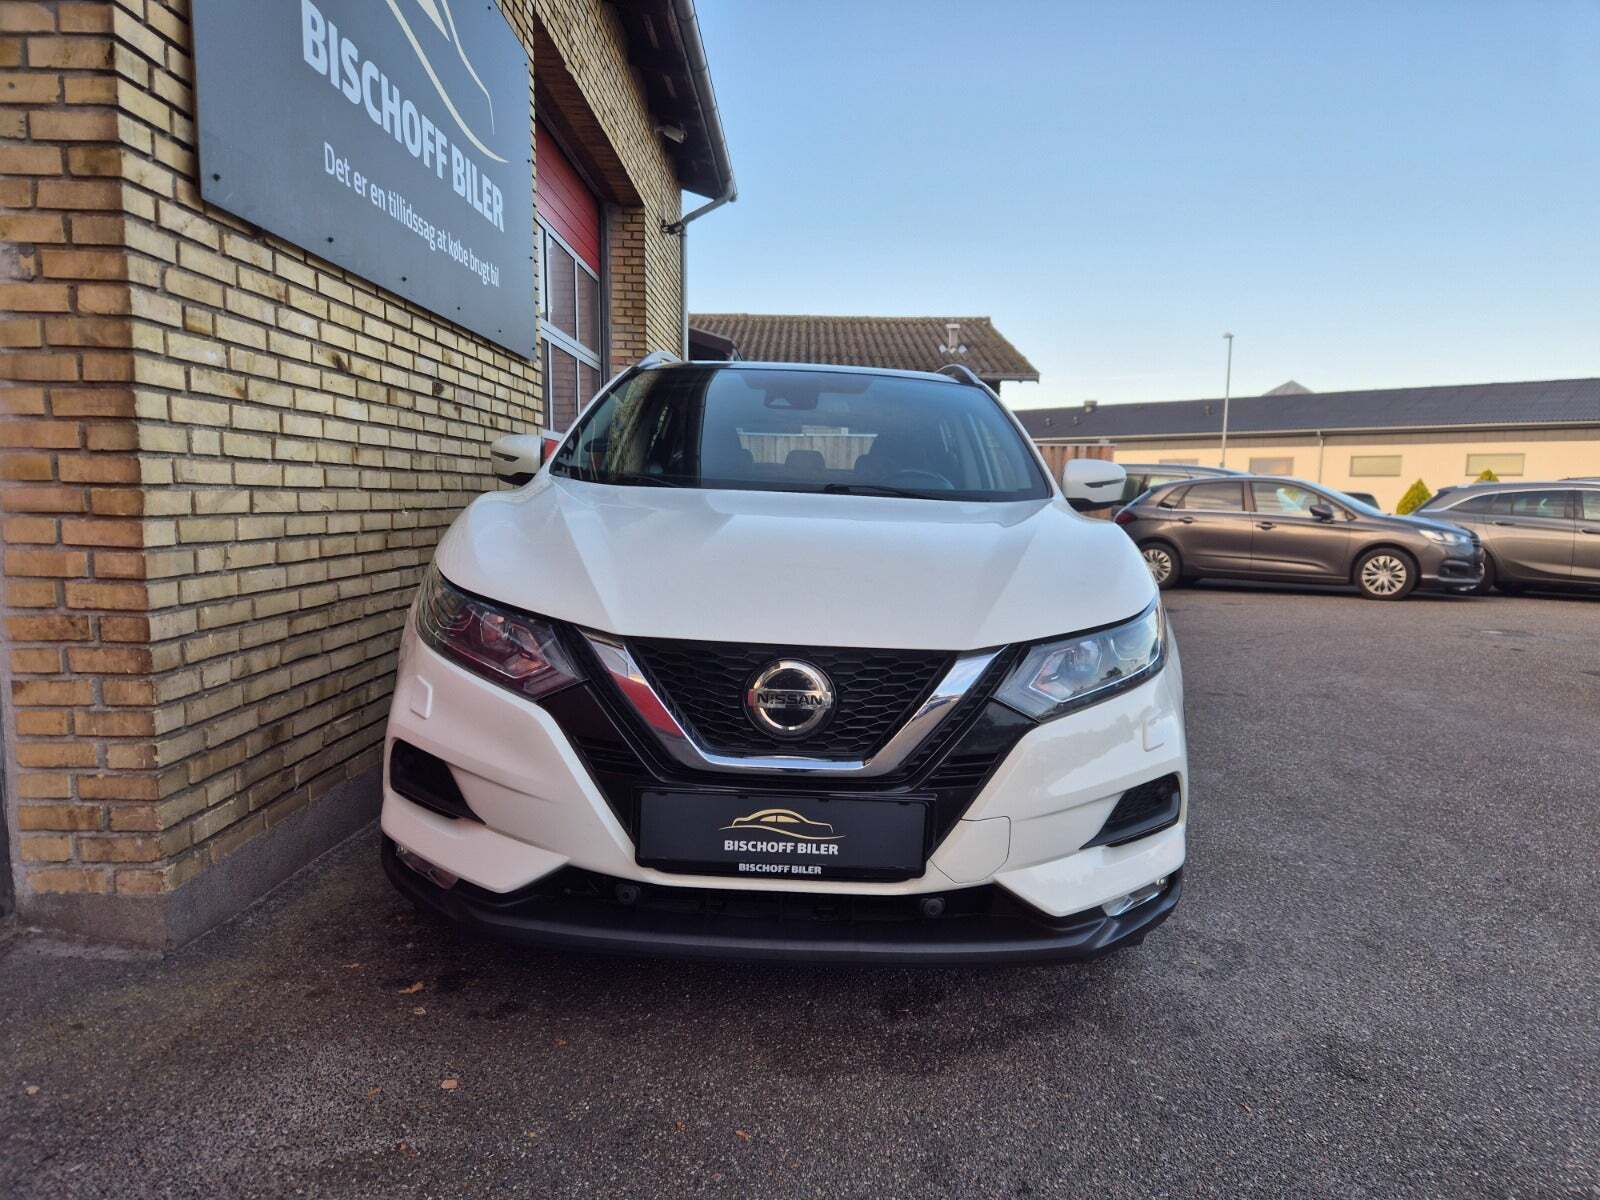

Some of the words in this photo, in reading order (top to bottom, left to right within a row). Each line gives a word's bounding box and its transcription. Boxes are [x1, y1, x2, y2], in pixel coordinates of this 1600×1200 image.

[301, 0, 448, 180] BISCHOFF
[451, 143, 505, 233] BILER
[324, 141, 351, 187] Det
[353, 171, 367, 198] er
[370, 182, 386, 211] en
[388, 191, 436, 251] tillidssag
[437, 229, 447, 253] at
[448, 231, 469, 267] købe
[470, 247, 490, 287] brugt
[490, 263, 500, 287] bil
[757, 692, 824, 706] NISSAN
[724, 840, 795, 854] BISCHOFF
[797, 842, 839, 856] BILER
[738, 863, 790, 874] BISCHOFF
[791, 865, 822, 875] BILER
